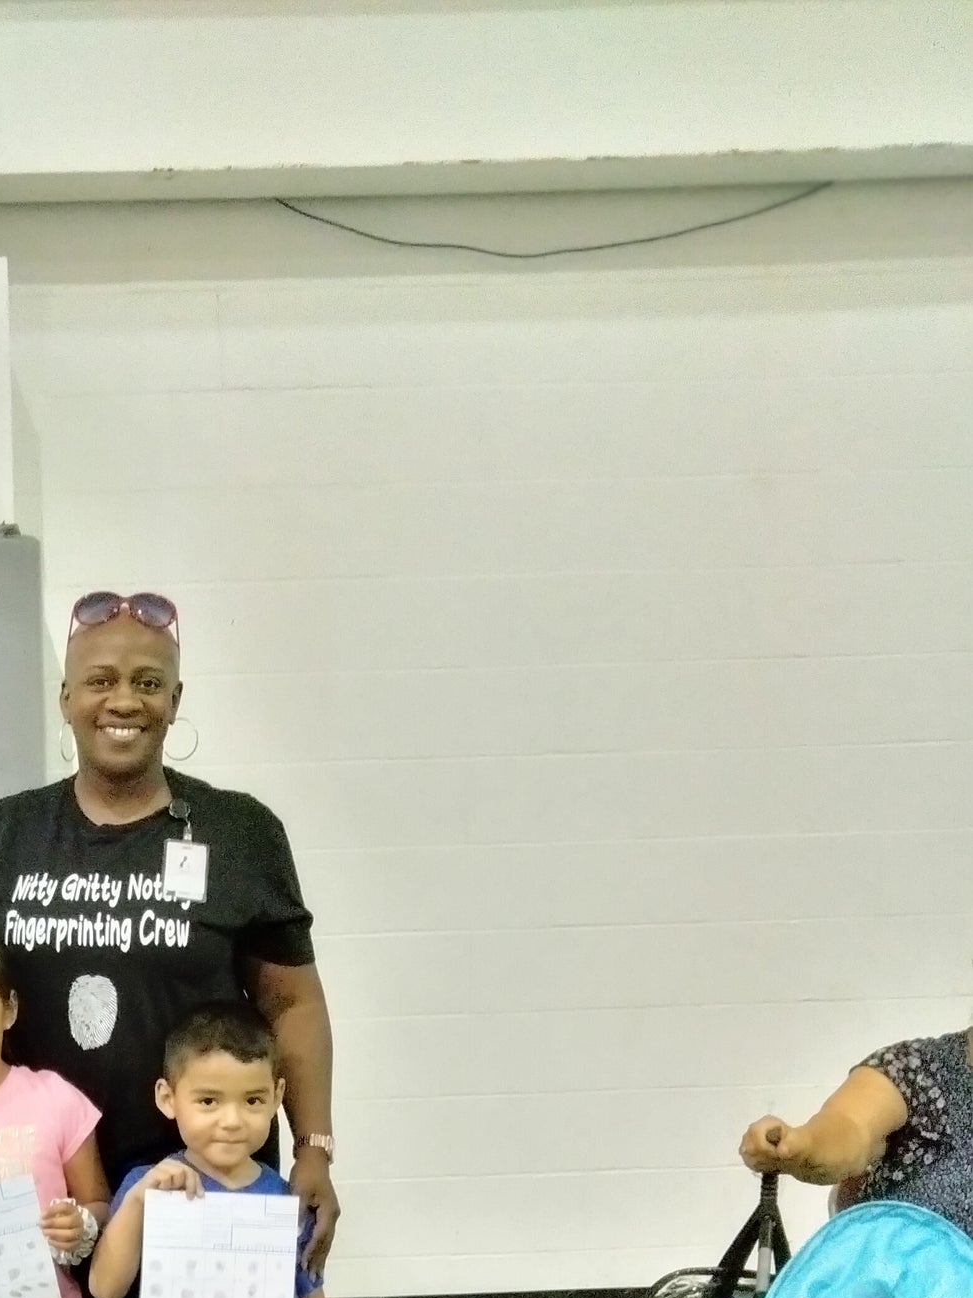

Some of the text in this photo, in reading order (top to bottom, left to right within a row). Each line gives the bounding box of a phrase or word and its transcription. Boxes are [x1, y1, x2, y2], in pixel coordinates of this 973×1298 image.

[12, 872, 191, 911] Nitty Gritty Not
[4, 909, 190, 953] Fingerprinting Crew
